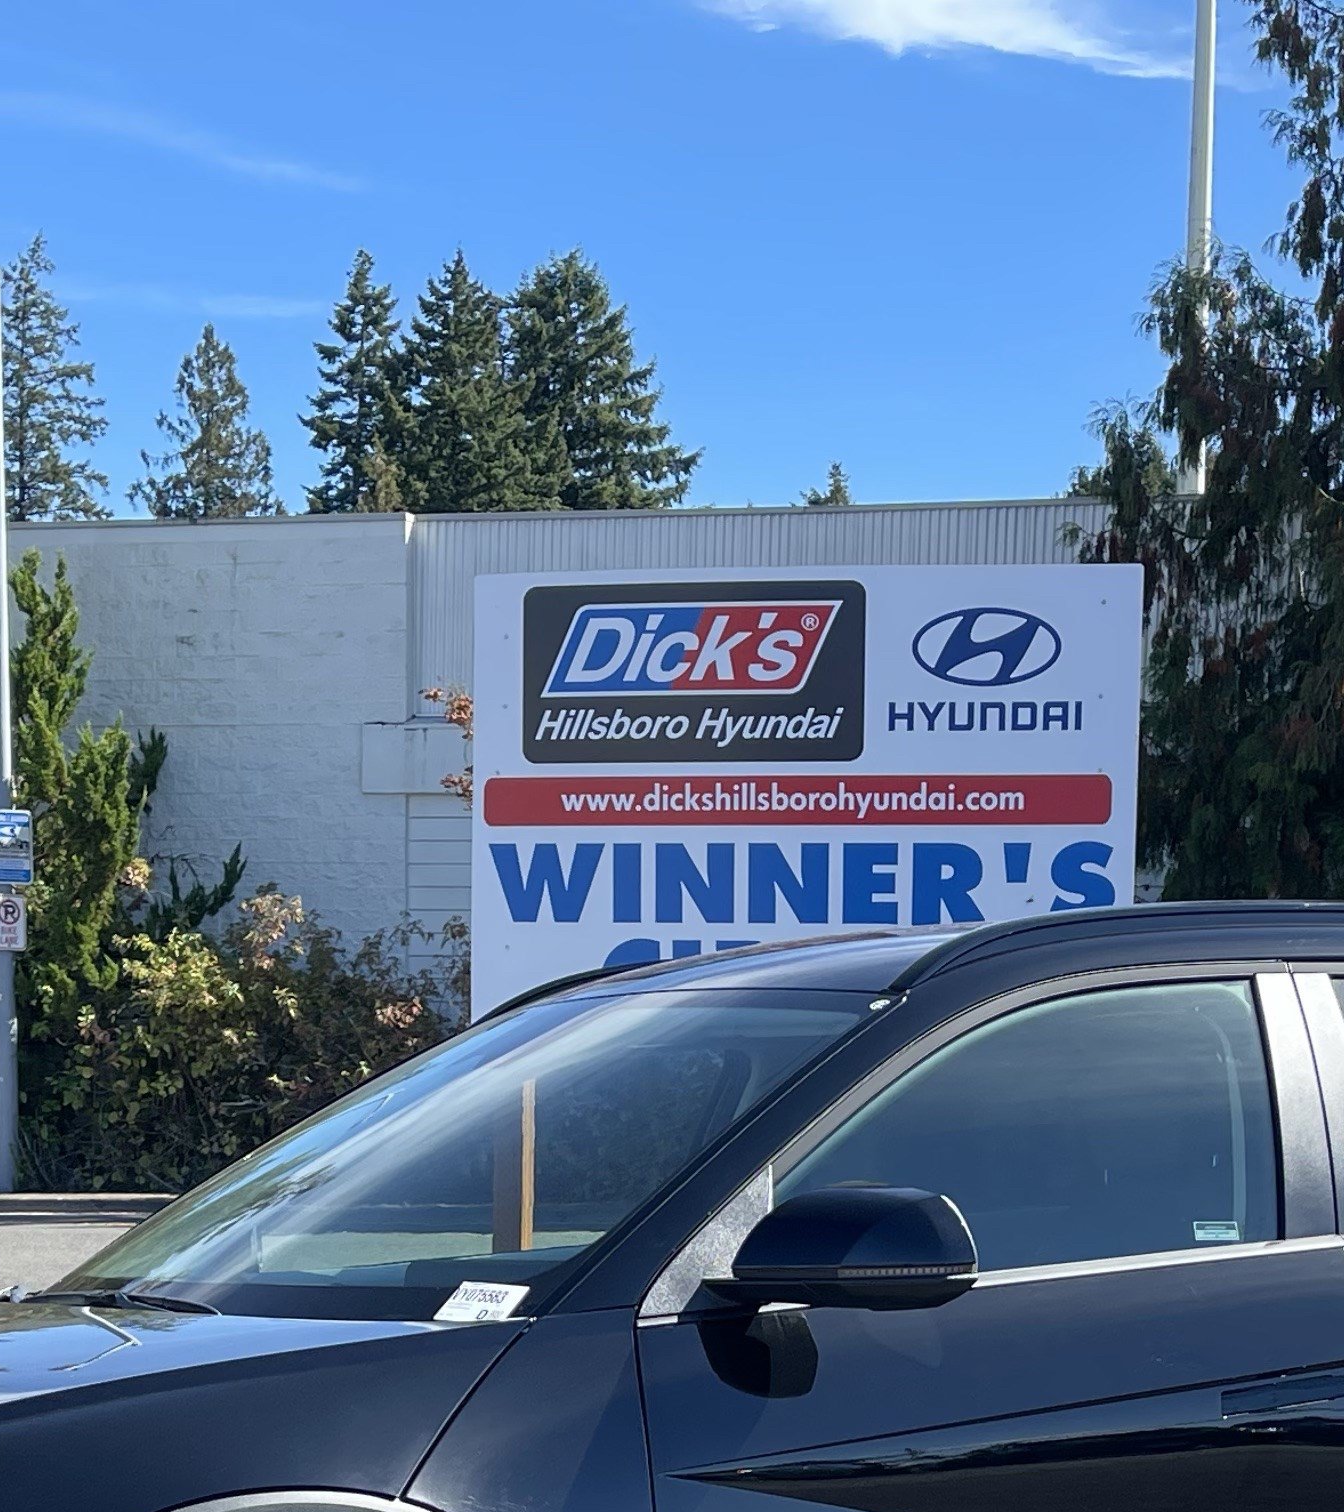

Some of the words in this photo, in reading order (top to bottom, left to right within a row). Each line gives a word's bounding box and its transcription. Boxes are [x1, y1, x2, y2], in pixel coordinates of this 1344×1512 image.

[565, 613, 803, 682] Dick's
[536, 709, 689, 740] Hillsboro
[696, 708, 843, 747] Hyundai
[889, 701, 1082, 731] HYUNDAI
[561, 782, 1024, 818] www.dickshillsborohyundai.com
[489, 841, 1115, 926] WINNER'S
